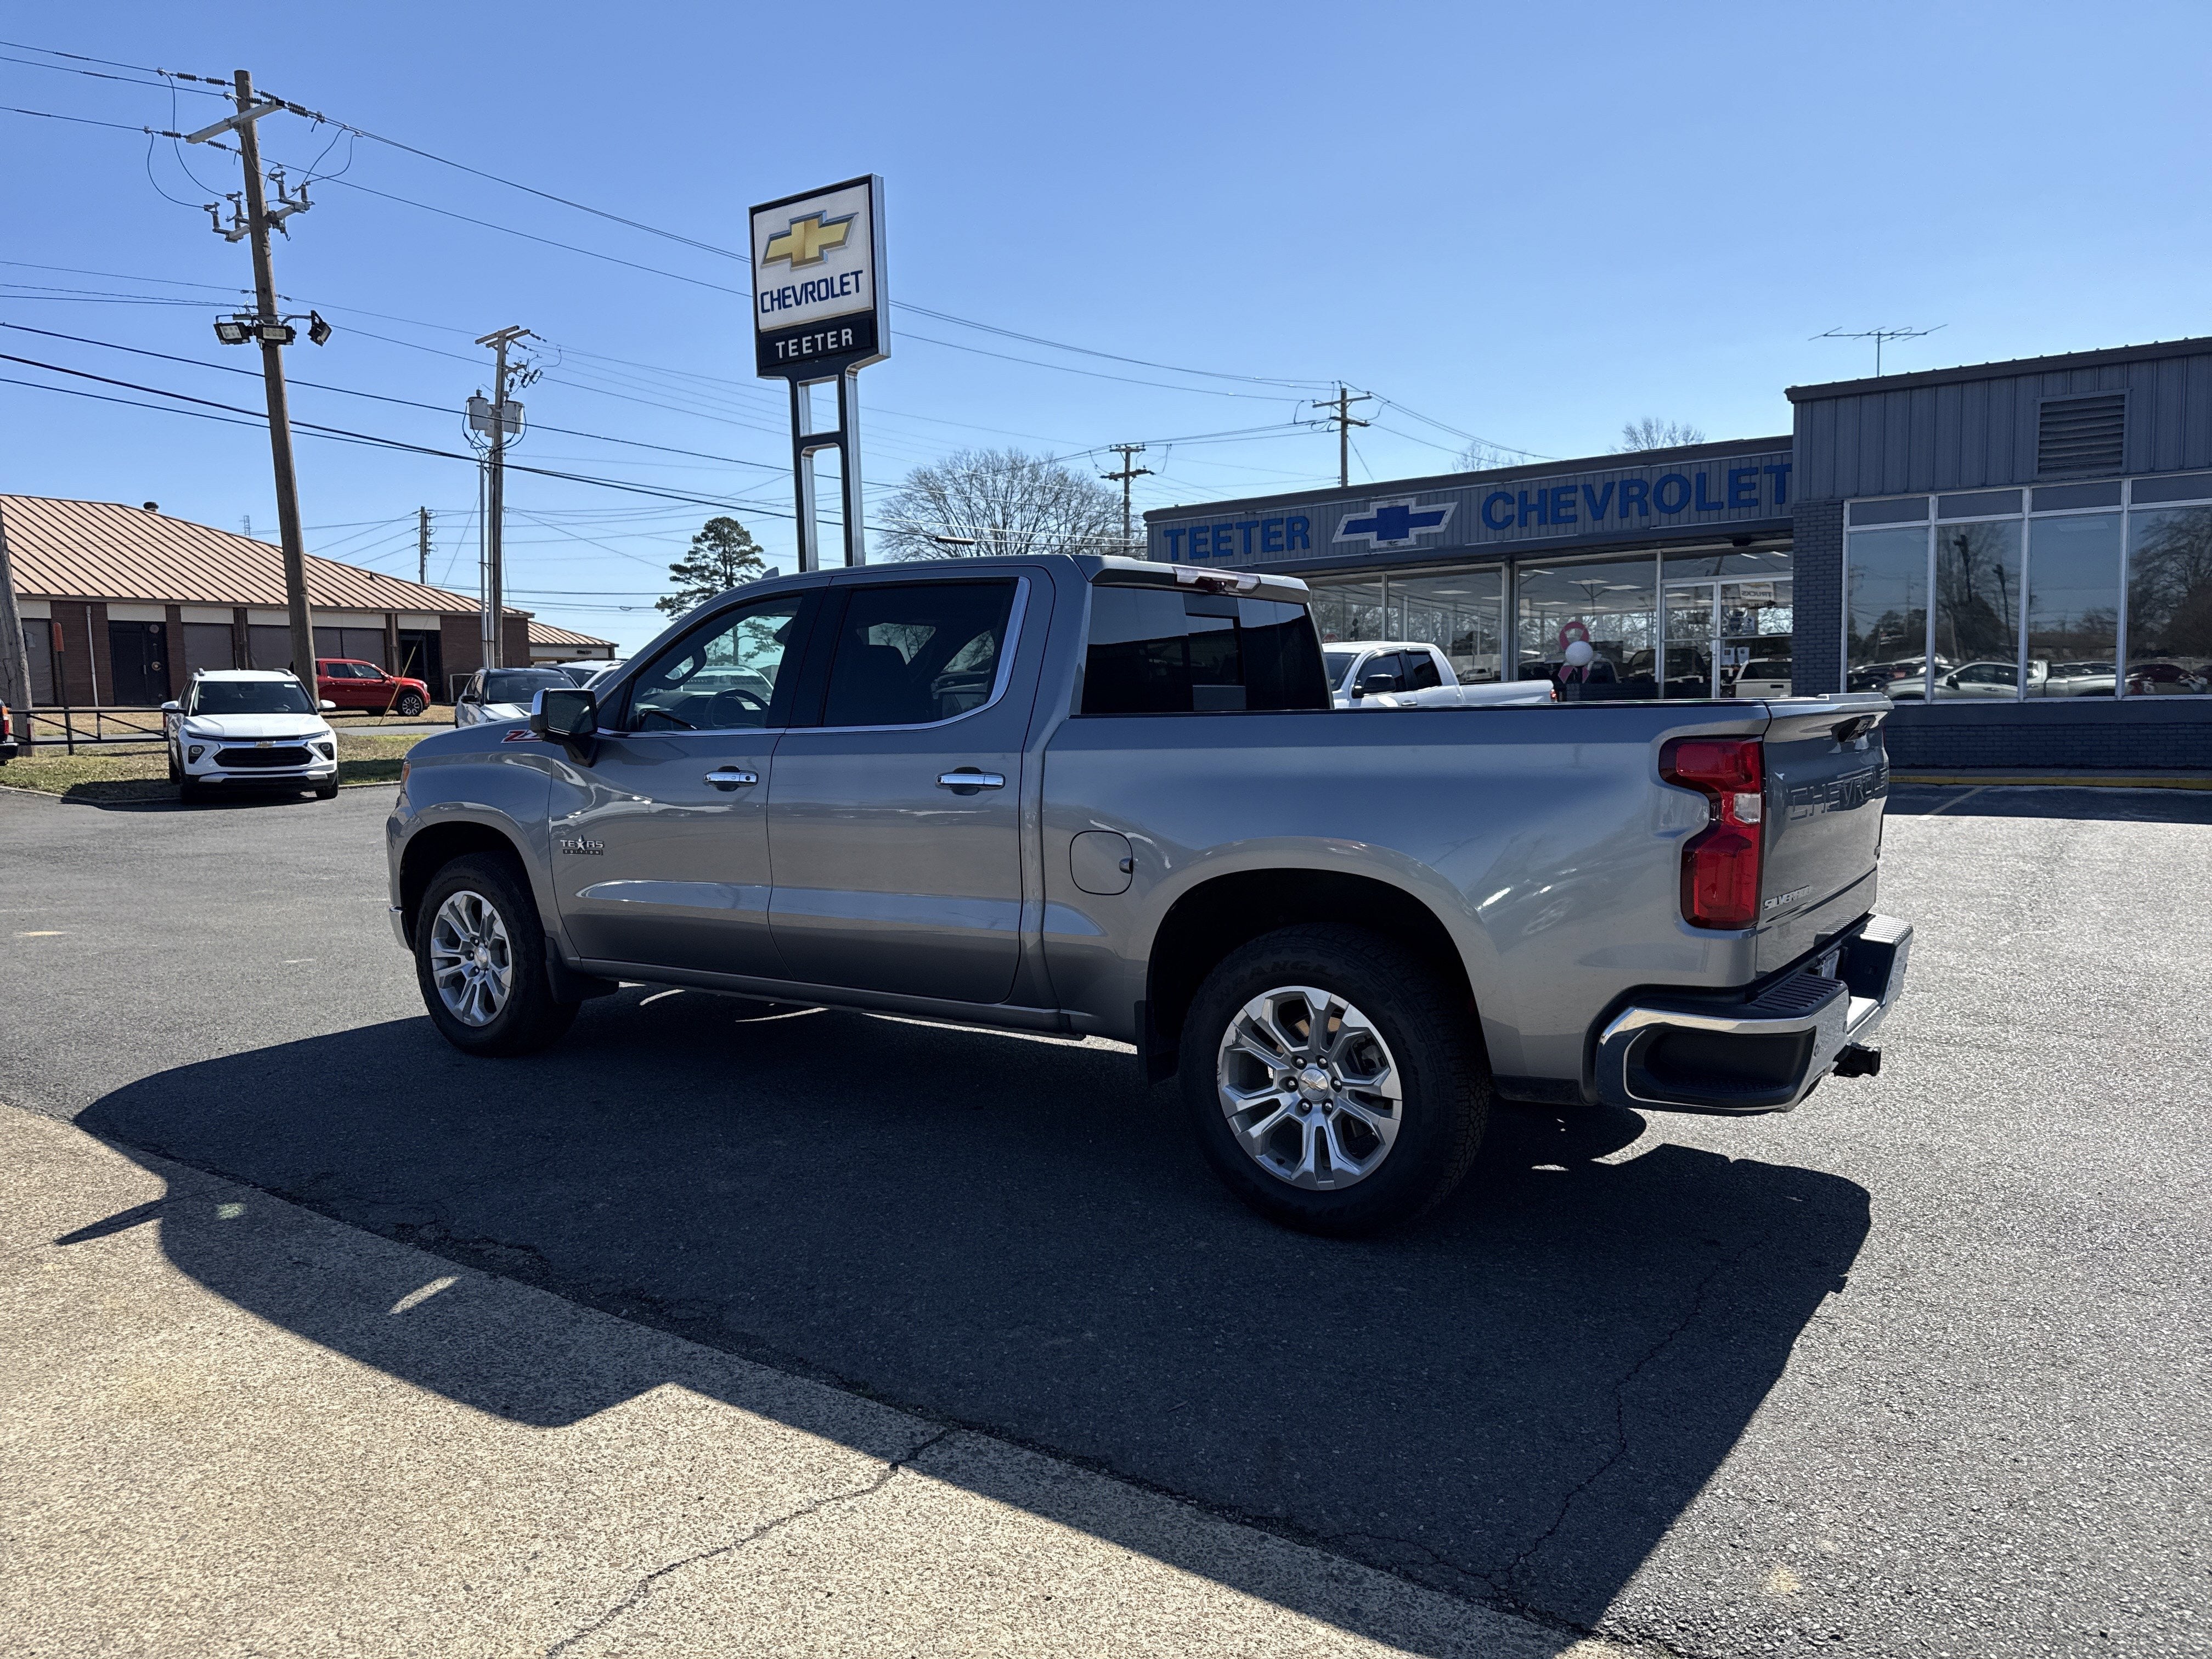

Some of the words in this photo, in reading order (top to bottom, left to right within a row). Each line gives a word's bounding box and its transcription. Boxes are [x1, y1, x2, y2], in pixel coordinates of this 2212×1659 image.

[760, 270, 863, 313] CHEVROLET
[775, 328, 853, 359] TEETER
[1163, 516, 1310, 562] TEETER
[1481, 463, 1792, 531] CHEVROLET
